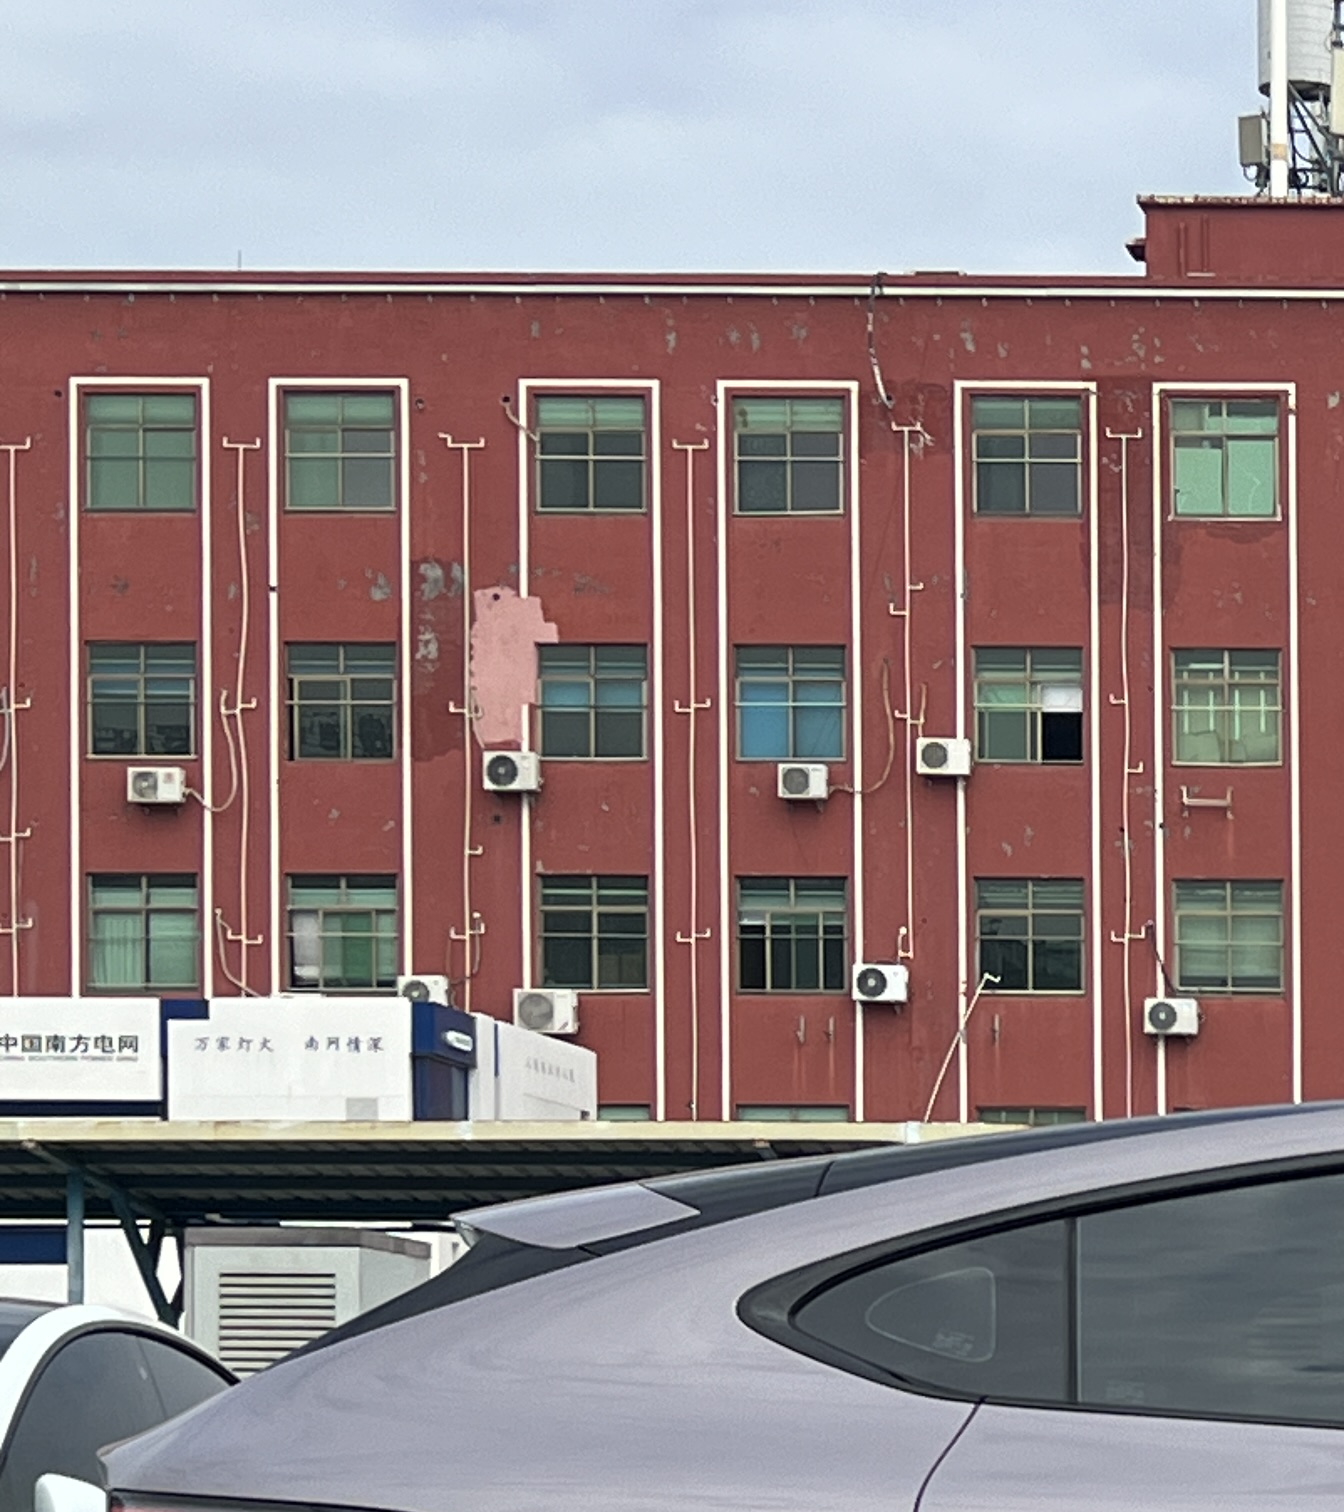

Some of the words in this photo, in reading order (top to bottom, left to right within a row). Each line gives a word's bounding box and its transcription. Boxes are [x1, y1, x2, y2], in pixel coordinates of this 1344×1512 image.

[0, 1033, 139, 1053] 中国南方电网
[195, 1035, 275, 1053] 万家灯火
